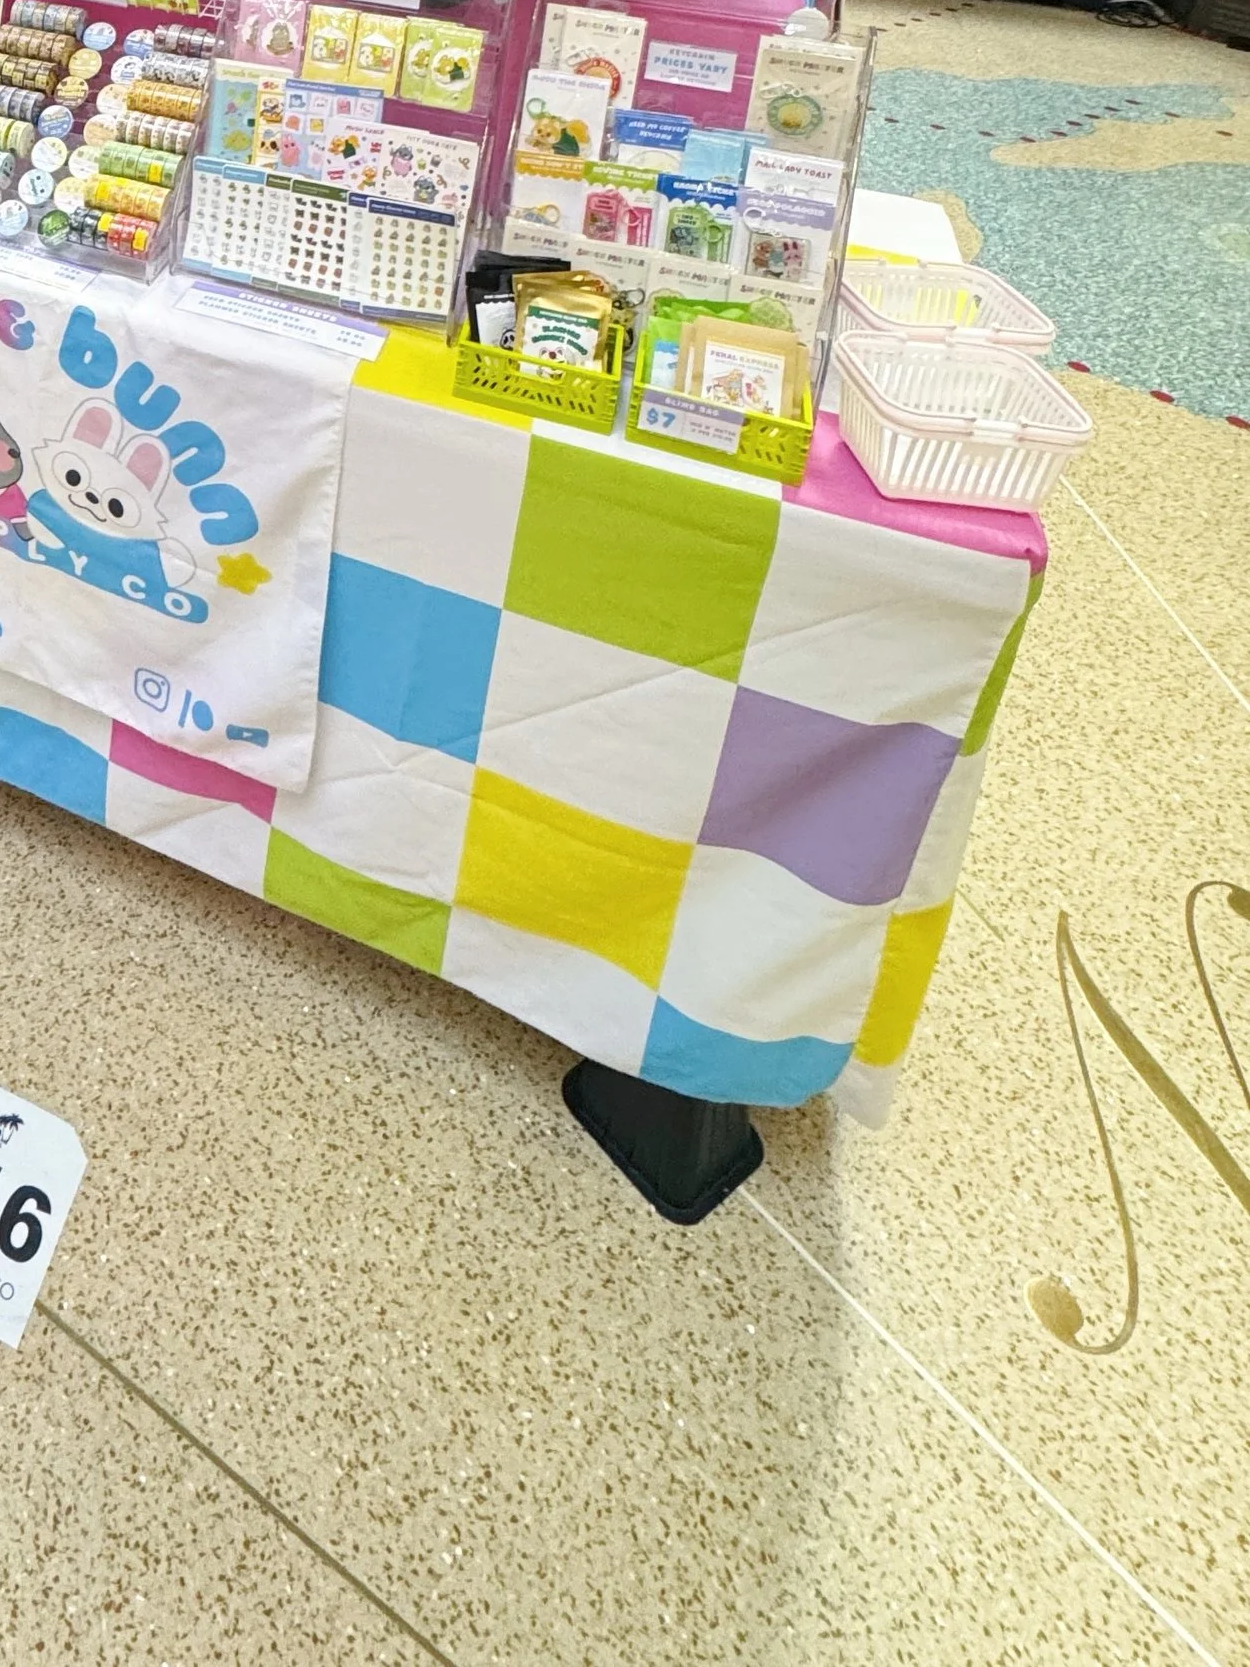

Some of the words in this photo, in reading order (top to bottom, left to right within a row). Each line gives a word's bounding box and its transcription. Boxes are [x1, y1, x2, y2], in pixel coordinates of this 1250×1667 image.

[654, 56, 694, 69] PRICES
[699, 63, 729, 74] VARY
[755, 160, 776, 169] MAIL
[804, 168, 833, 179] TOAST
[238, 292, 288, 309] STICKER
[665, 397, 697, 411] BLIND
[699, 405, 719, 417] BAG
[59, 304, 259, 546] bunn
[646, 407, 676, 428] $7
[122, 574, 192, 617] CO
